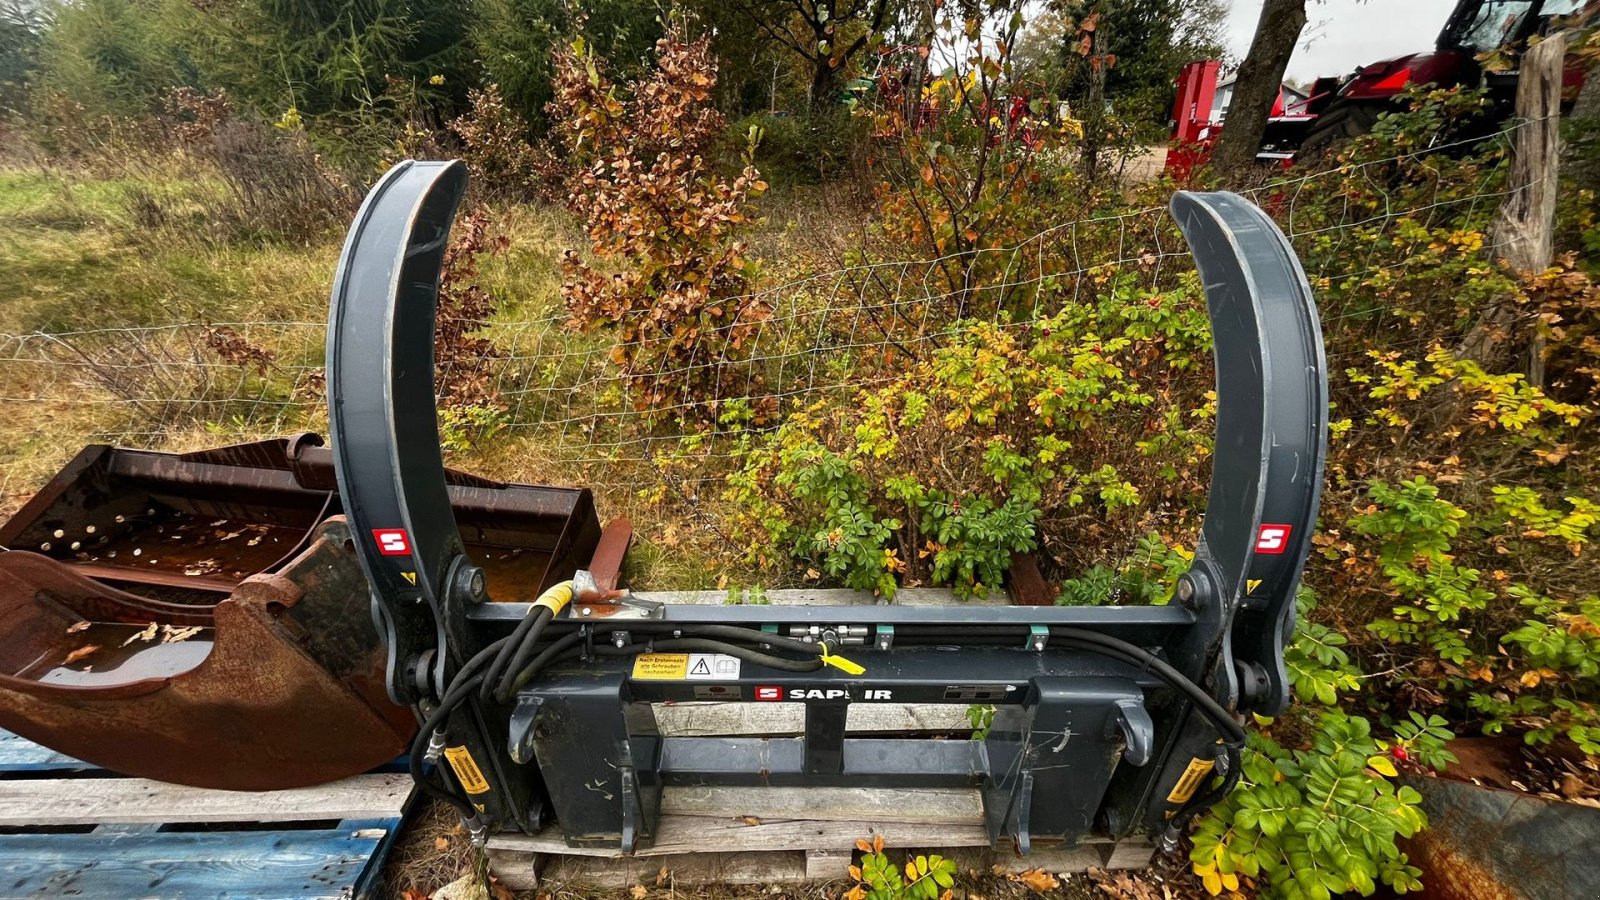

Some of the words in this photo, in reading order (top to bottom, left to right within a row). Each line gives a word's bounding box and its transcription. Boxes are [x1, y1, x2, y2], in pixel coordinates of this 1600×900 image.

[380, 533, 406, 551] S
[1258, 529, 1285, 548] S
[789, 689, 892, 699] SAPIR
